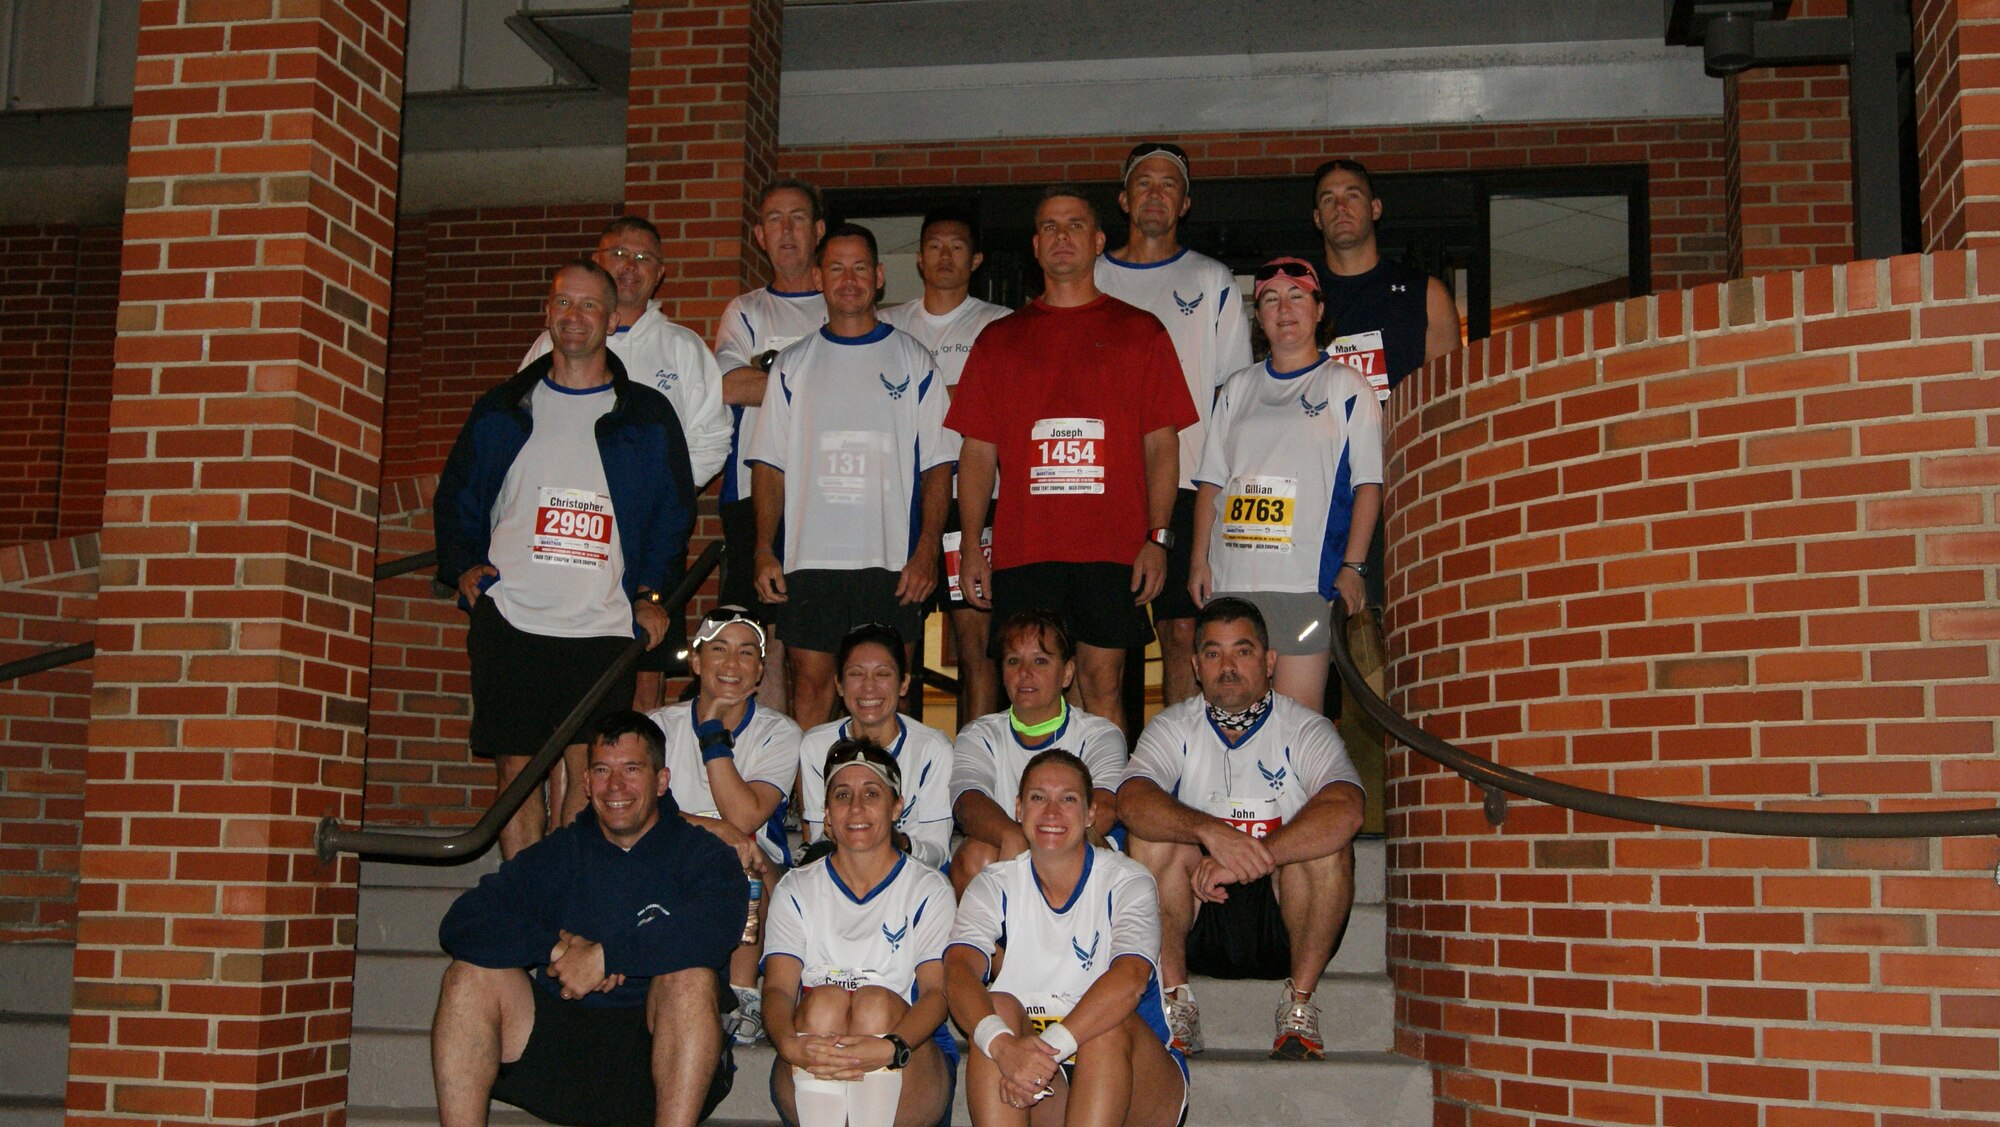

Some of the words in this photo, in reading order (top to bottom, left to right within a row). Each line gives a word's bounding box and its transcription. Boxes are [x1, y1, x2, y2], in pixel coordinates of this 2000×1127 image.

[1335, 344, 1358, 354] Mark
[1050, 428, 1083, 439] Joseph
[1038, 441, 1096, 464] 1454
[1245, 484, 1273, 495] Gillian
[550, 496, 604, 513] Christopher
[1231, 498, 1285, 523] 8763
[544, 510, 605, 540] 2990
[1231, 808, 1255, 819] John
